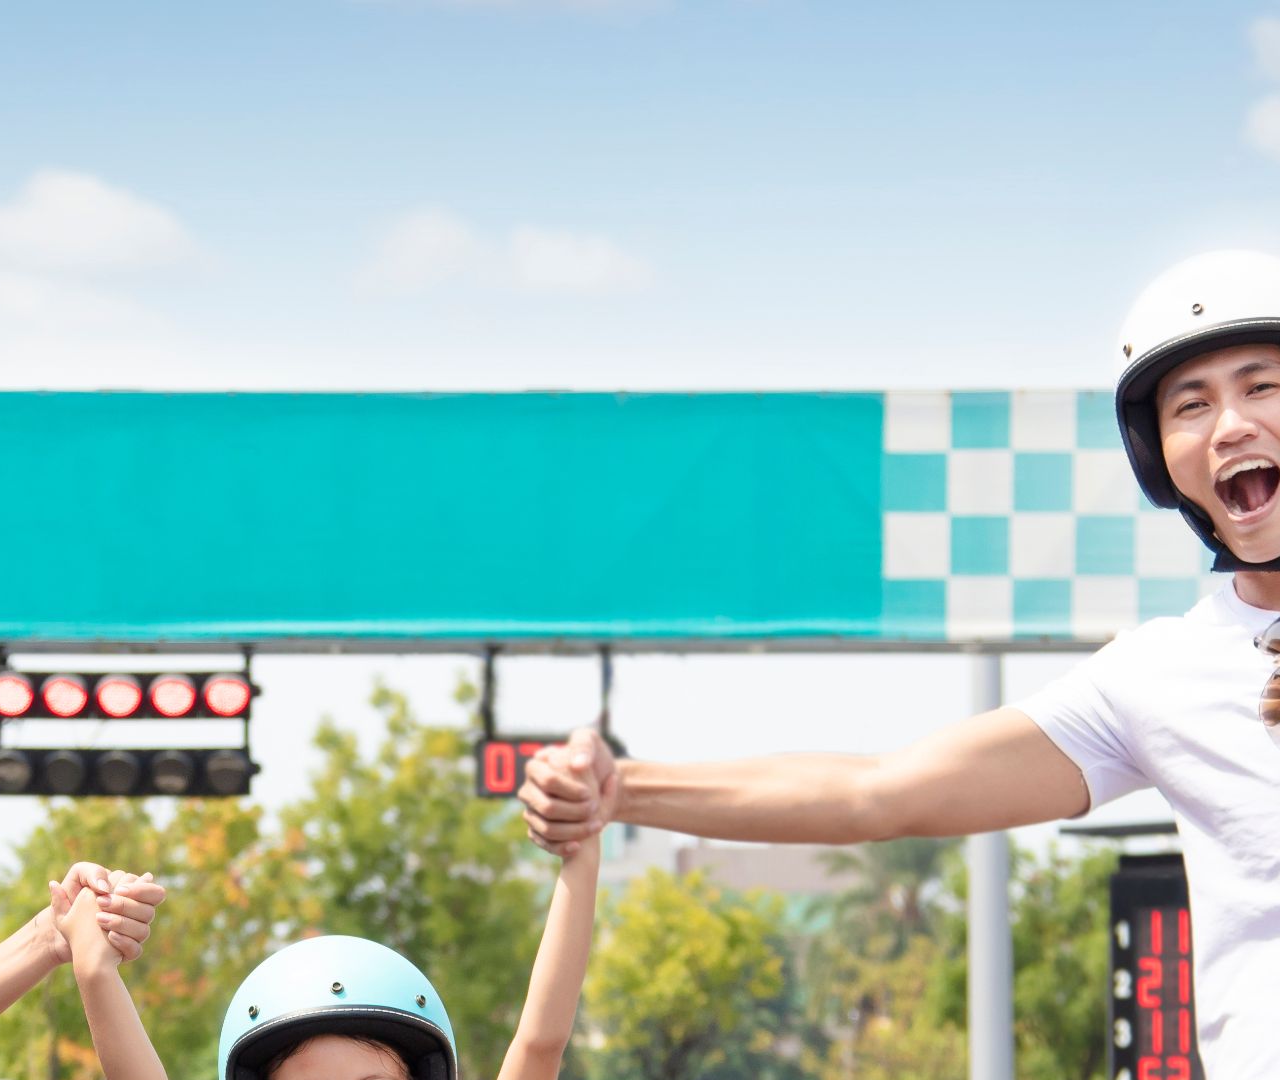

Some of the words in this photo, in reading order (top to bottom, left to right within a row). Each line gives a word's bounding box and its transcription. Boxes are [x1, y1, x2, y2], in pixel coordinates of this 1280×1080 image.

[1151, 909, 1190, 955] 11
[1114, 968, 1132, 999] 2
[1136, 956, 1190, 1008] 21
[1114, 1017, 1132, 1048] 3
[1151, 1008, 1190, 1055] 11
